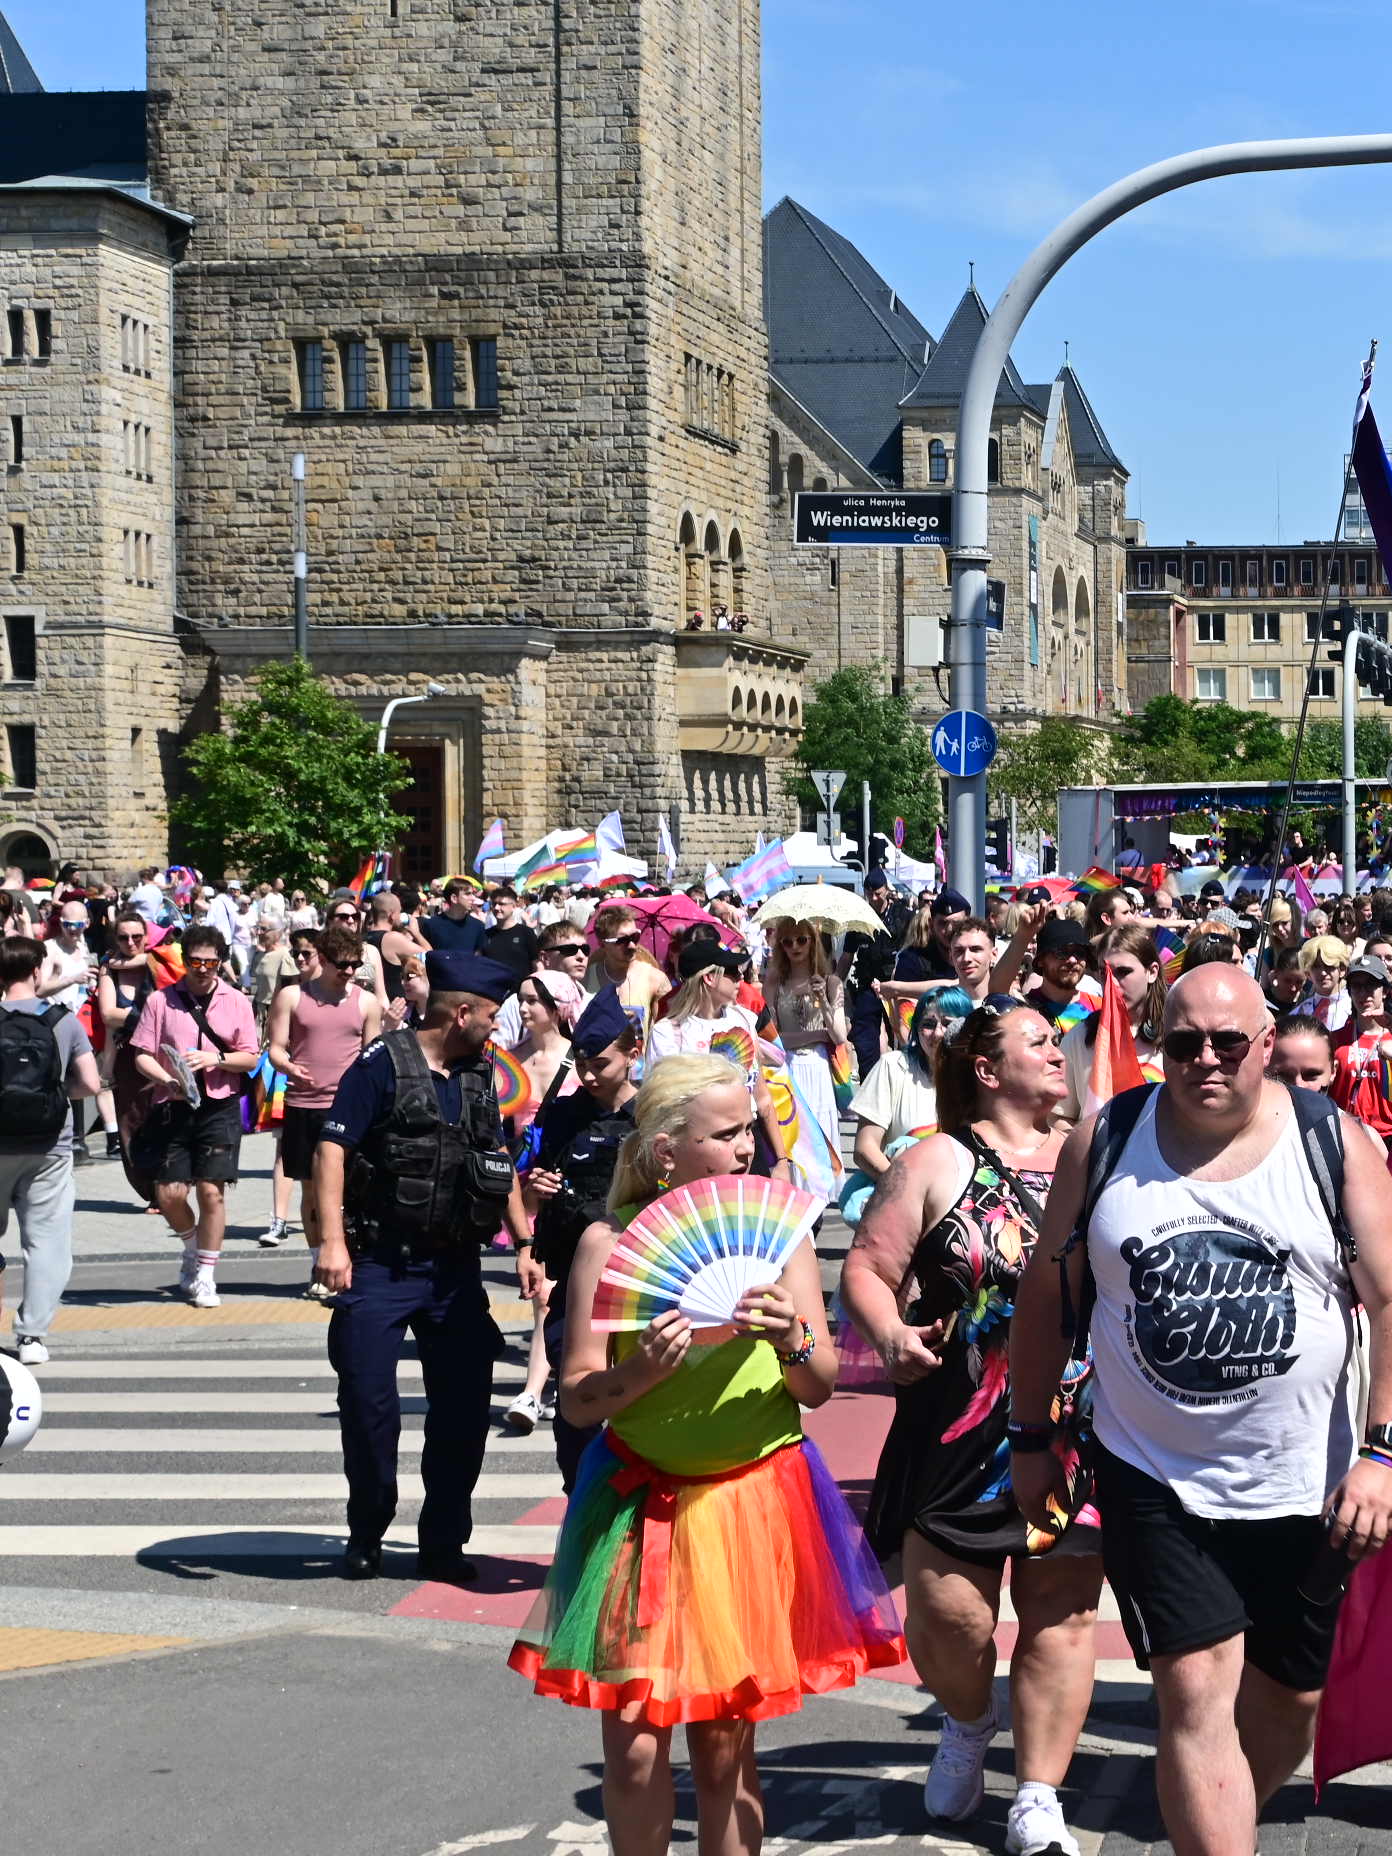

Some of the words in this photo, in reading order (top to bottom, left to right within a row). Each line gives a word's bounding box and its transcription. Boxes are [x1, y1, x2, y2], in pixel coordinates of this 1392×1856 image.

[843, 497, 865, 506] ulica
[870, 497, 906, 508] Henryka
[810, 510, 939, 531] Wieniawskiego
[485, 1159, 511, 1173] POLICJA
[1151, 1216, 1186, 1238] CAREFULLY
[1187, 1214, 1219, 1225] SELECTED
[1221, 1366, 1248, 1379] VTNG
[1251, 1364, 1259, 1377] &
[1261, 1362, 1278, 1376] CO.
[1222, 1388, 1258, 1404] AUTHENTIC
